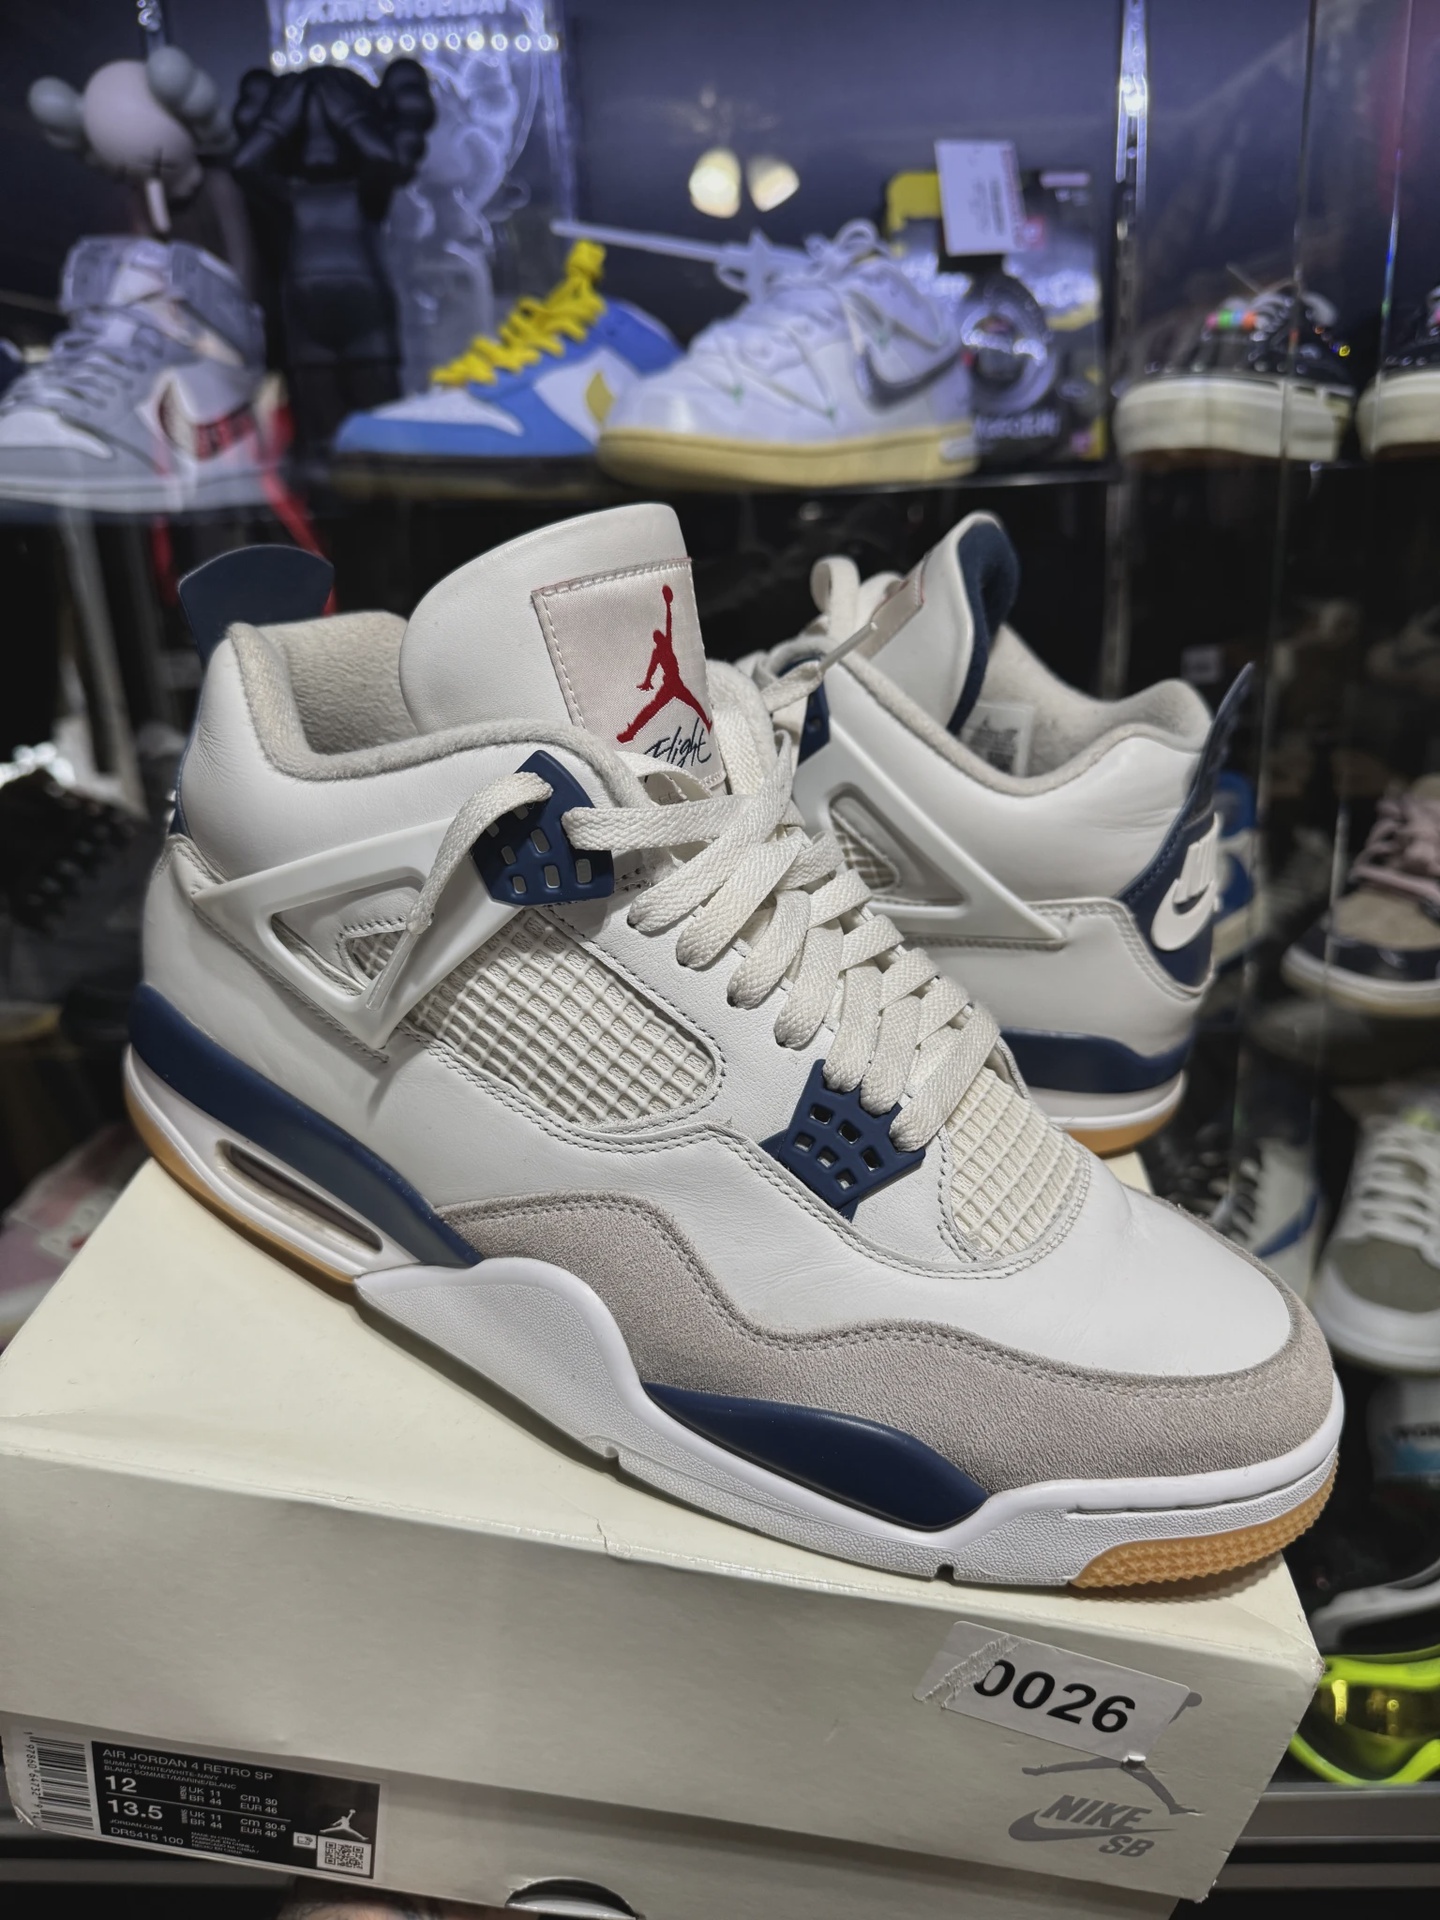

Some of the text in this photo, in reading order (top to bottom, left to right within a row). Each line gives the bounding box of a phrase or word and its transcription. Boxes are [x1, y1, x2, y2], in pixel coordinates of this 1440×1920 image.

[643, 717, 712, 768] Flight
[973, 1658, 1136, 1734] 0026
[102, 1749, 273, 1780] AIR JORDAN 4 RETRO SP
[103, 1759, 137, 1768] SUMMIT
[104, 1765, 237, 1789] BLANC SOMMET/MARINE/BLANC
[105, 1775, 137, 1793] 12
[189, 1786, 205, 1795] UK
[189, 1795, 205, 1803] BR
[240, 1793, 278, 1806] cm 30
[107, 1799, 163, 1820] 13.5
[190, 1810, 206, 1819] UK
[240, 1802, 278, 1815] EUR 46
[1040, 1794, 1153, 1830] NIKE
[109, 1819, 163, 1831] JORDAN.COM
[190, 1818, 206, 1827] BR
[240, 1818, 286, 1831] cm 30.5
[111, 1827, 184, 1845] DR5415 100
[240, 1826, 278, 1838] EUR 46
[1098, 1834, 1156, 1858] SB
